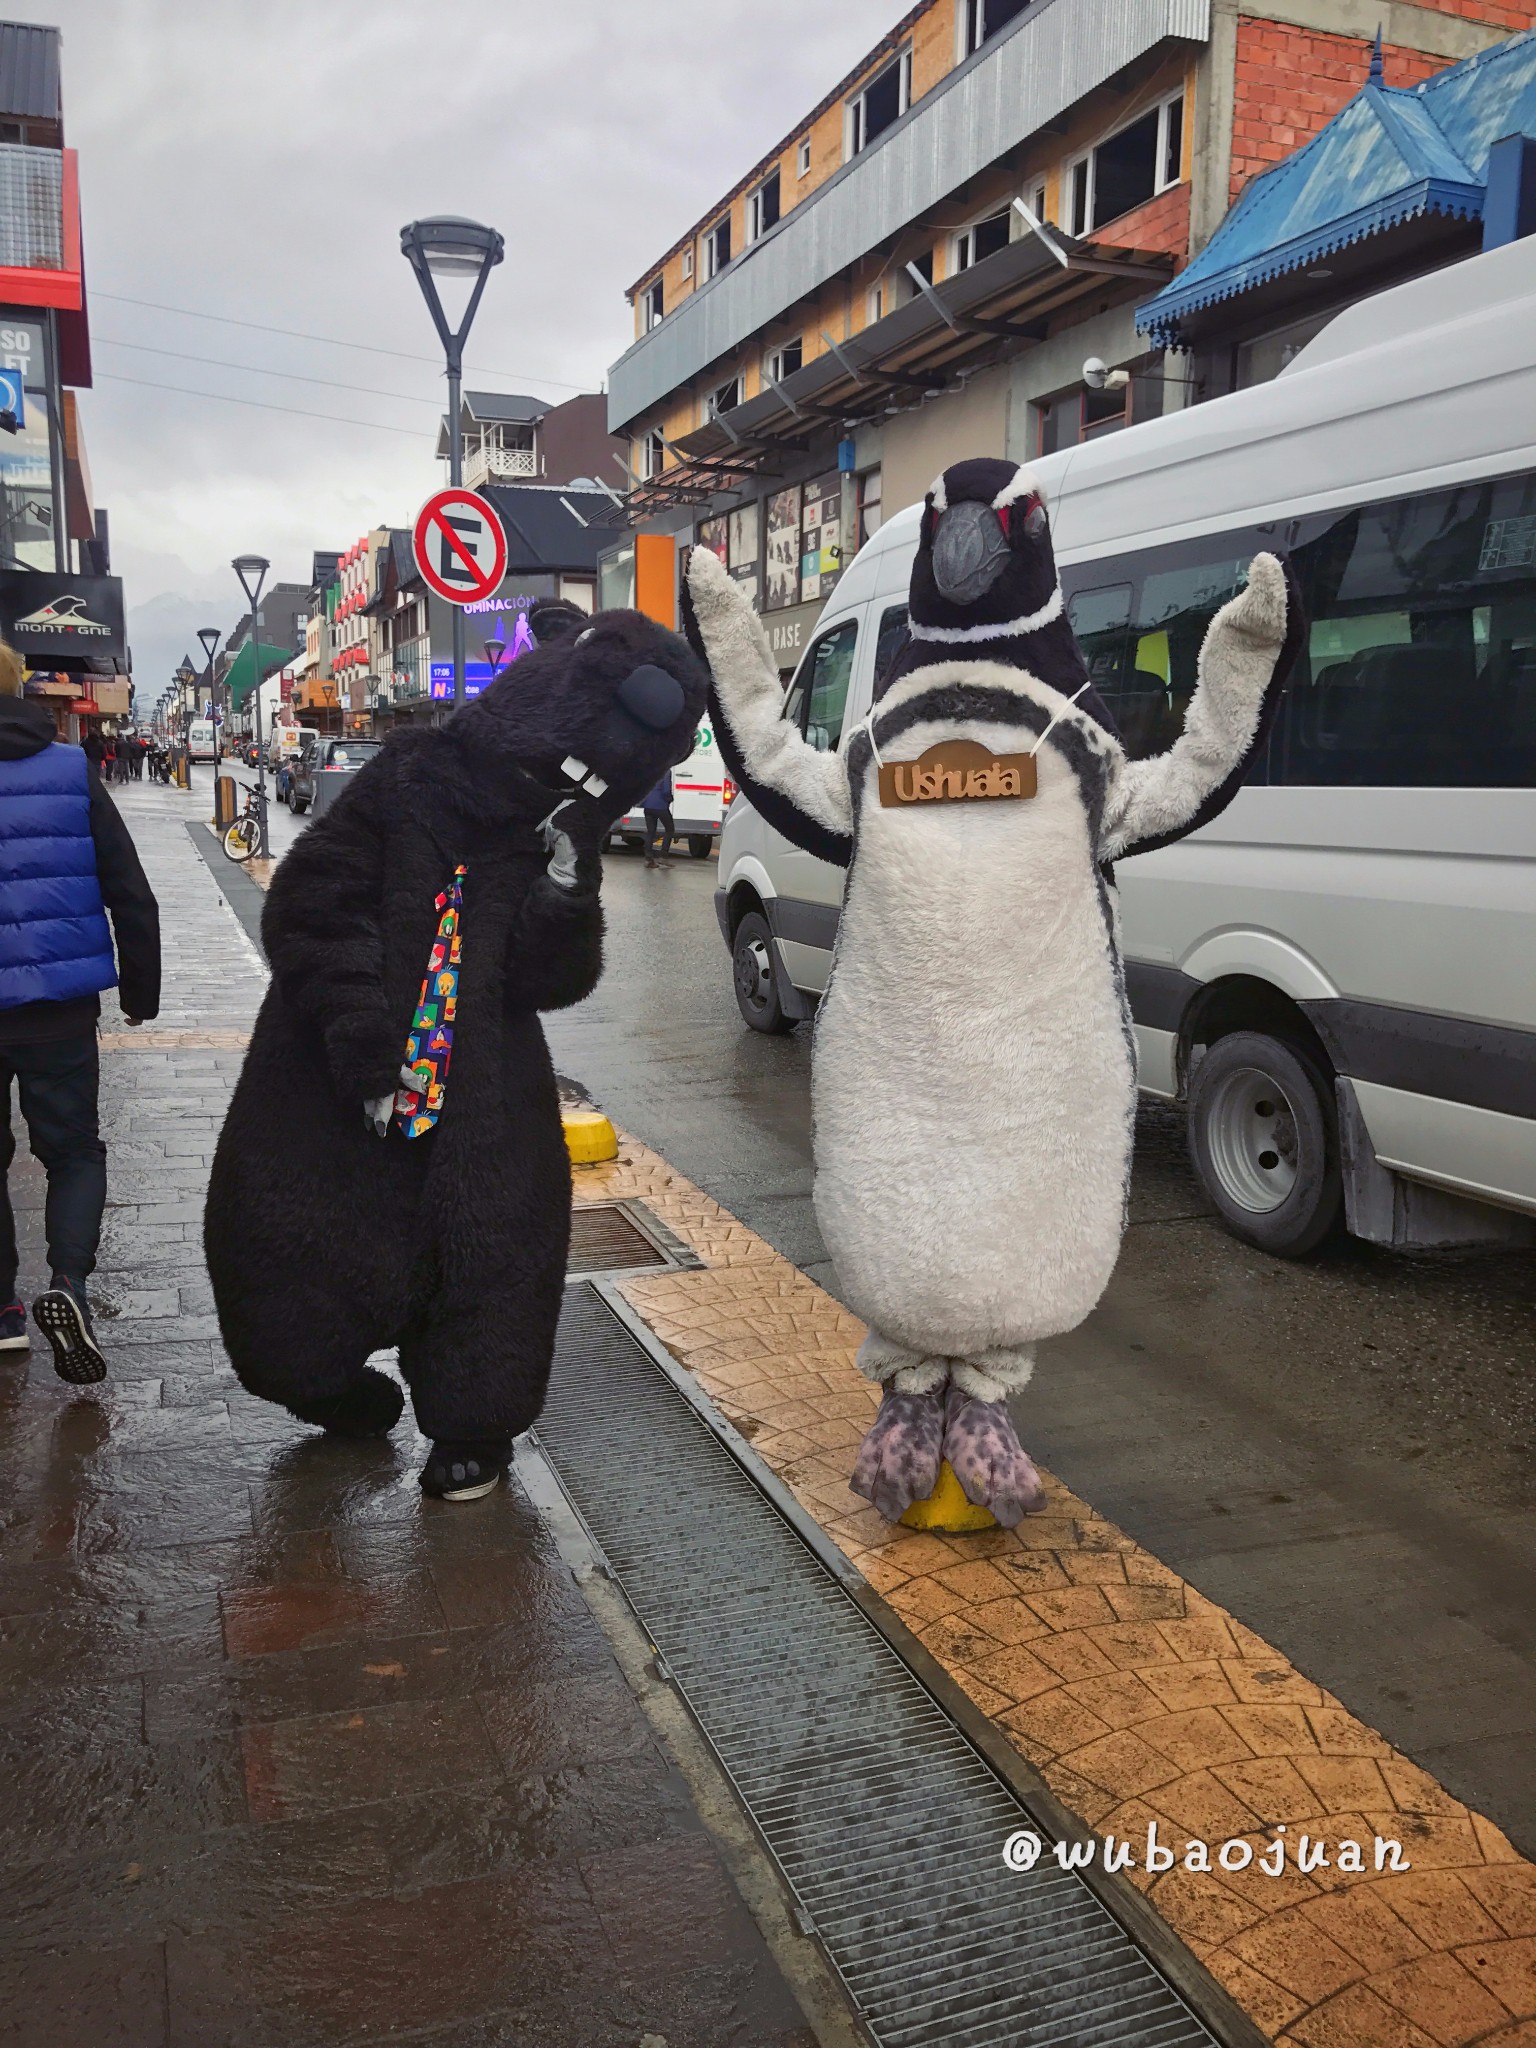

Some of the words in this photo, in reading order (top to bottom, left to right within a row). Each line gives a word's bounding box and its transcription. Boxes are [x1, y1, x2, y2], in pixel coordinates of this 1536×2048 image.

[440, 515, 482, 584] E
[14, 622, 112, 636] MONTGNE
[773, 623, 801, 651] BASE
[894, 762, 1021, 802] Ushuaia
